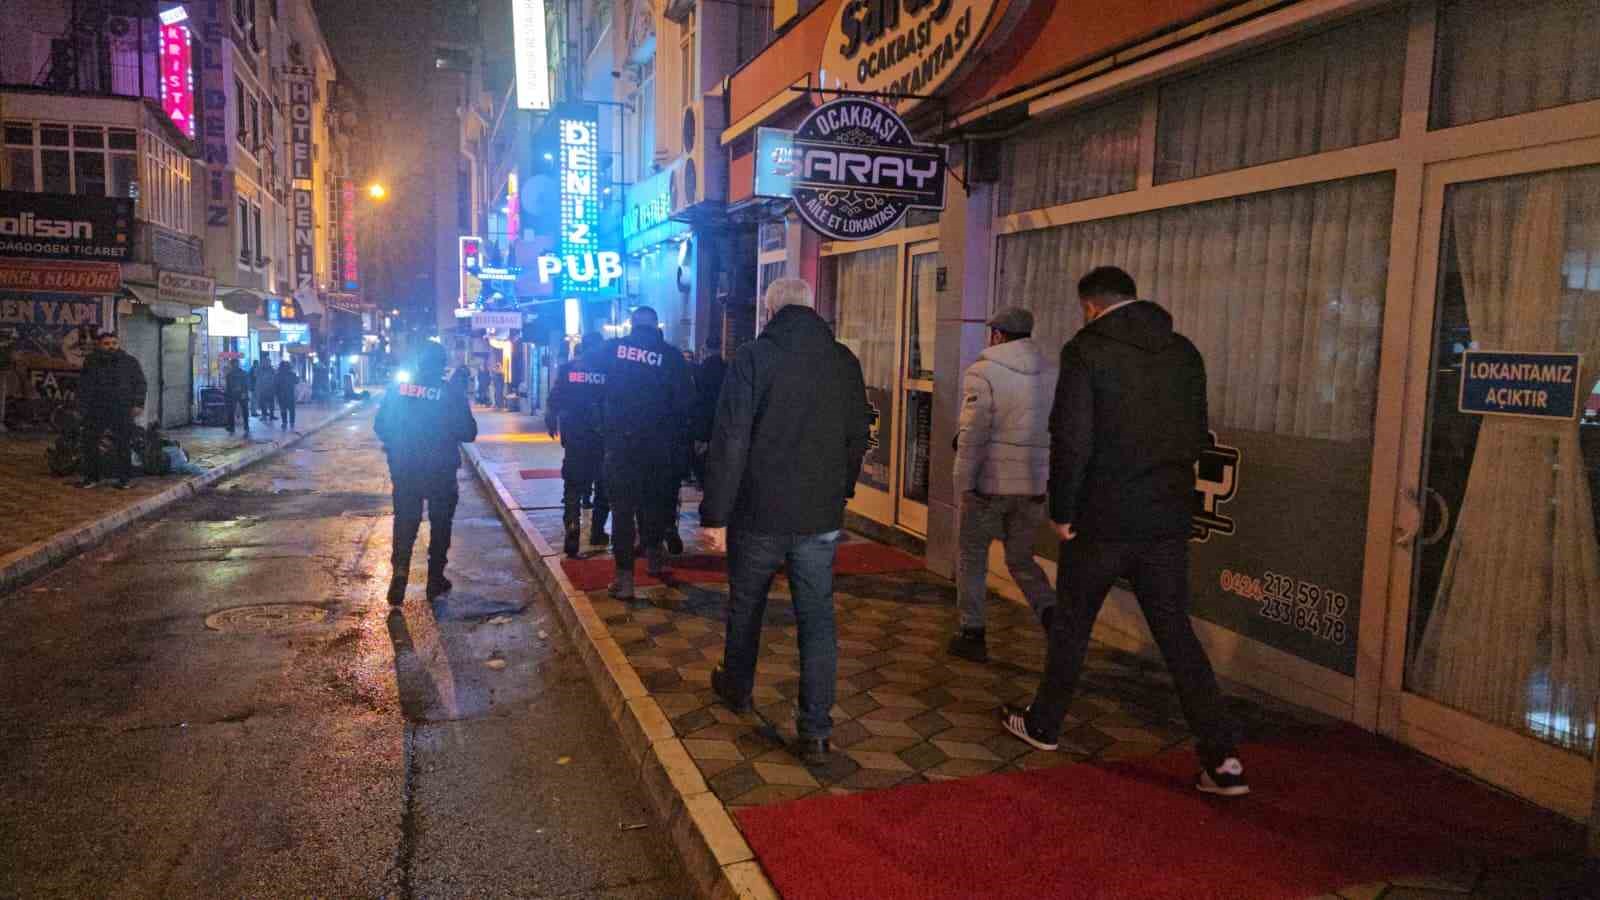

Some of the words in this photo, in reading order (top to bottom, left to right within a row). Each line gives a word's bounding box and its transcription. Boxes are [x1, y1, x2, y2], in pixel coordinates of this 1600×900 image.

[858, 19, 931, 84] OCAKBAŞI
[816, 105, 899, 143] OCAKBAŞI
[769, 147, 938, 188] SARAY
[827, 213, 843, 231] ET
[843, 204, 898, 233] LOKANTASI
[537, 251, 623, 288] PUB
[1470, 361, 1573, 383] LOKANTAMIZ
[1485, 387, 1548, 408] AÇIKTIR
[1263, 570, 1294, 600] 212
[1296, 581, 1320, 608] 59
[1325, 589, 1347, 617] 19
[1260, 594, 1293, 624] 233
[1296, 607, 1320, 636] 84
[1321, 615, 1347, 645] 78
